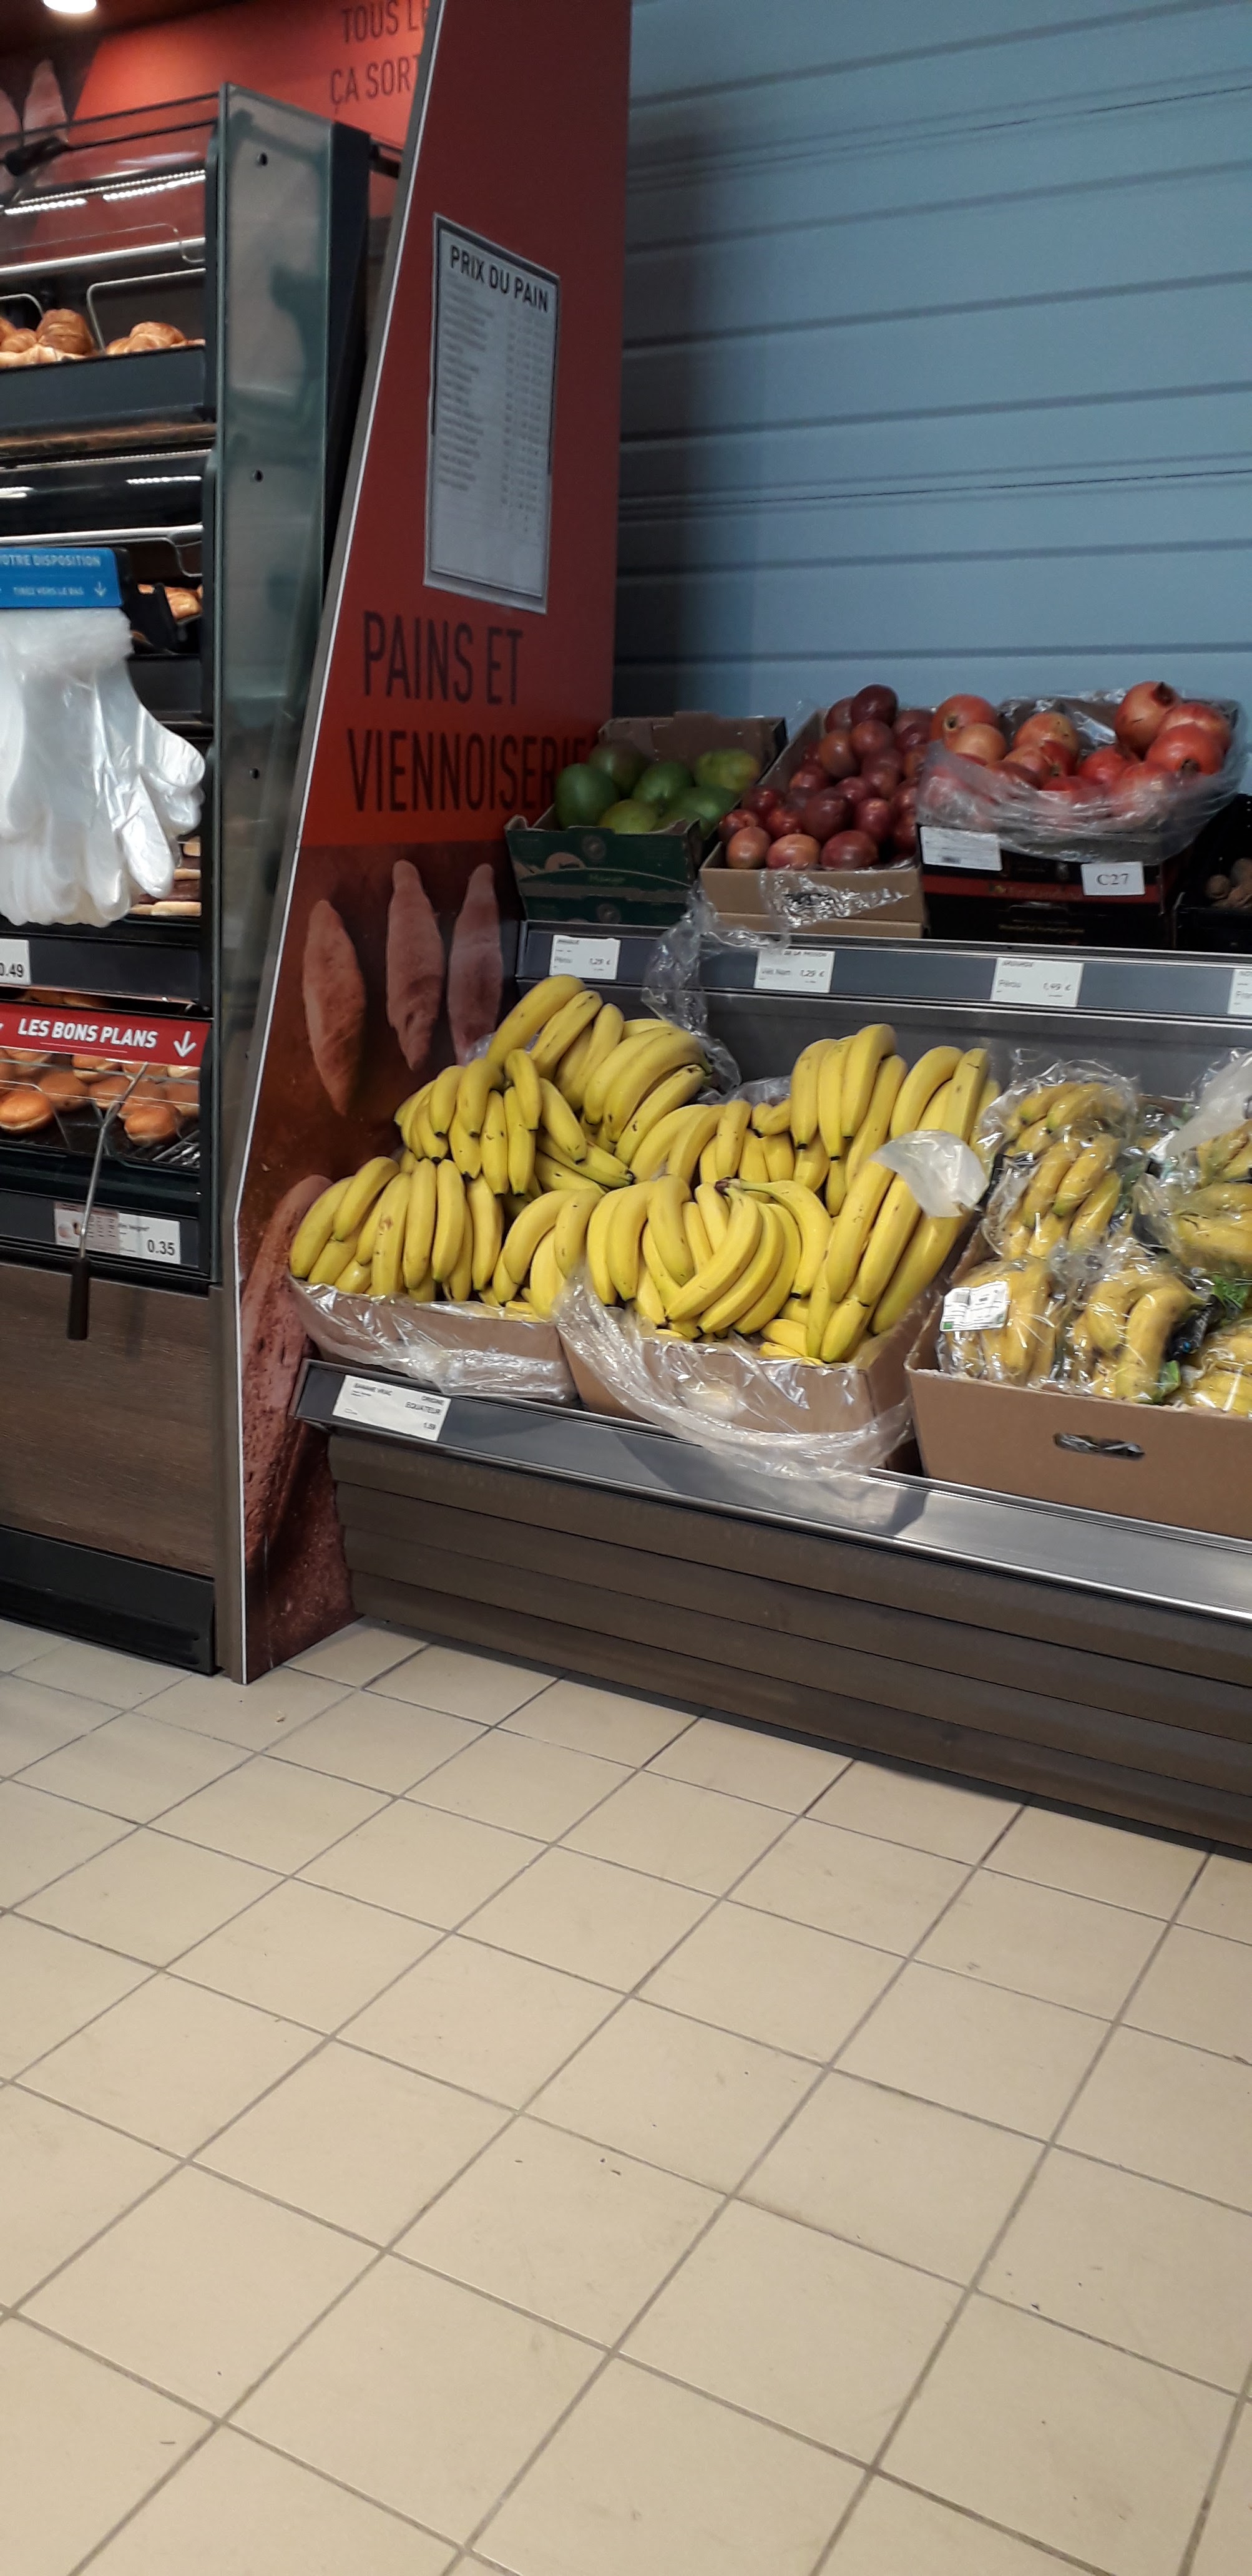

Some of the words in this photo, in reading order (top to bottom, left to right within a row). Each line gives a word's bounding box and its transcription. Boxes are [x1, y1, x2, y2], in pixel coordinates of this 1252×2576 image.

[341, 1, 399, 43] TOUS
[331, 66, 360, 114] ÇA
[450, 244, 486, 283] PRIX
[489, 265, 510, 294] DU
[513, 276, 550, 313] PAIN
[32, 555, 102, 567] DISPOSITION
[363, 610, 474, 703] PAINS
[486, 626, 524, 706] ET
[1097, 873, 1128, 886] C27
[0, 962, 23, 978] 0.49
[18, 1018, 51, 1038] LES
[52, 1021, 99, 1042] BONS
[99, 1027, 159, 1048] PLANS
[147, 1239, 175, 1256] 0.35
